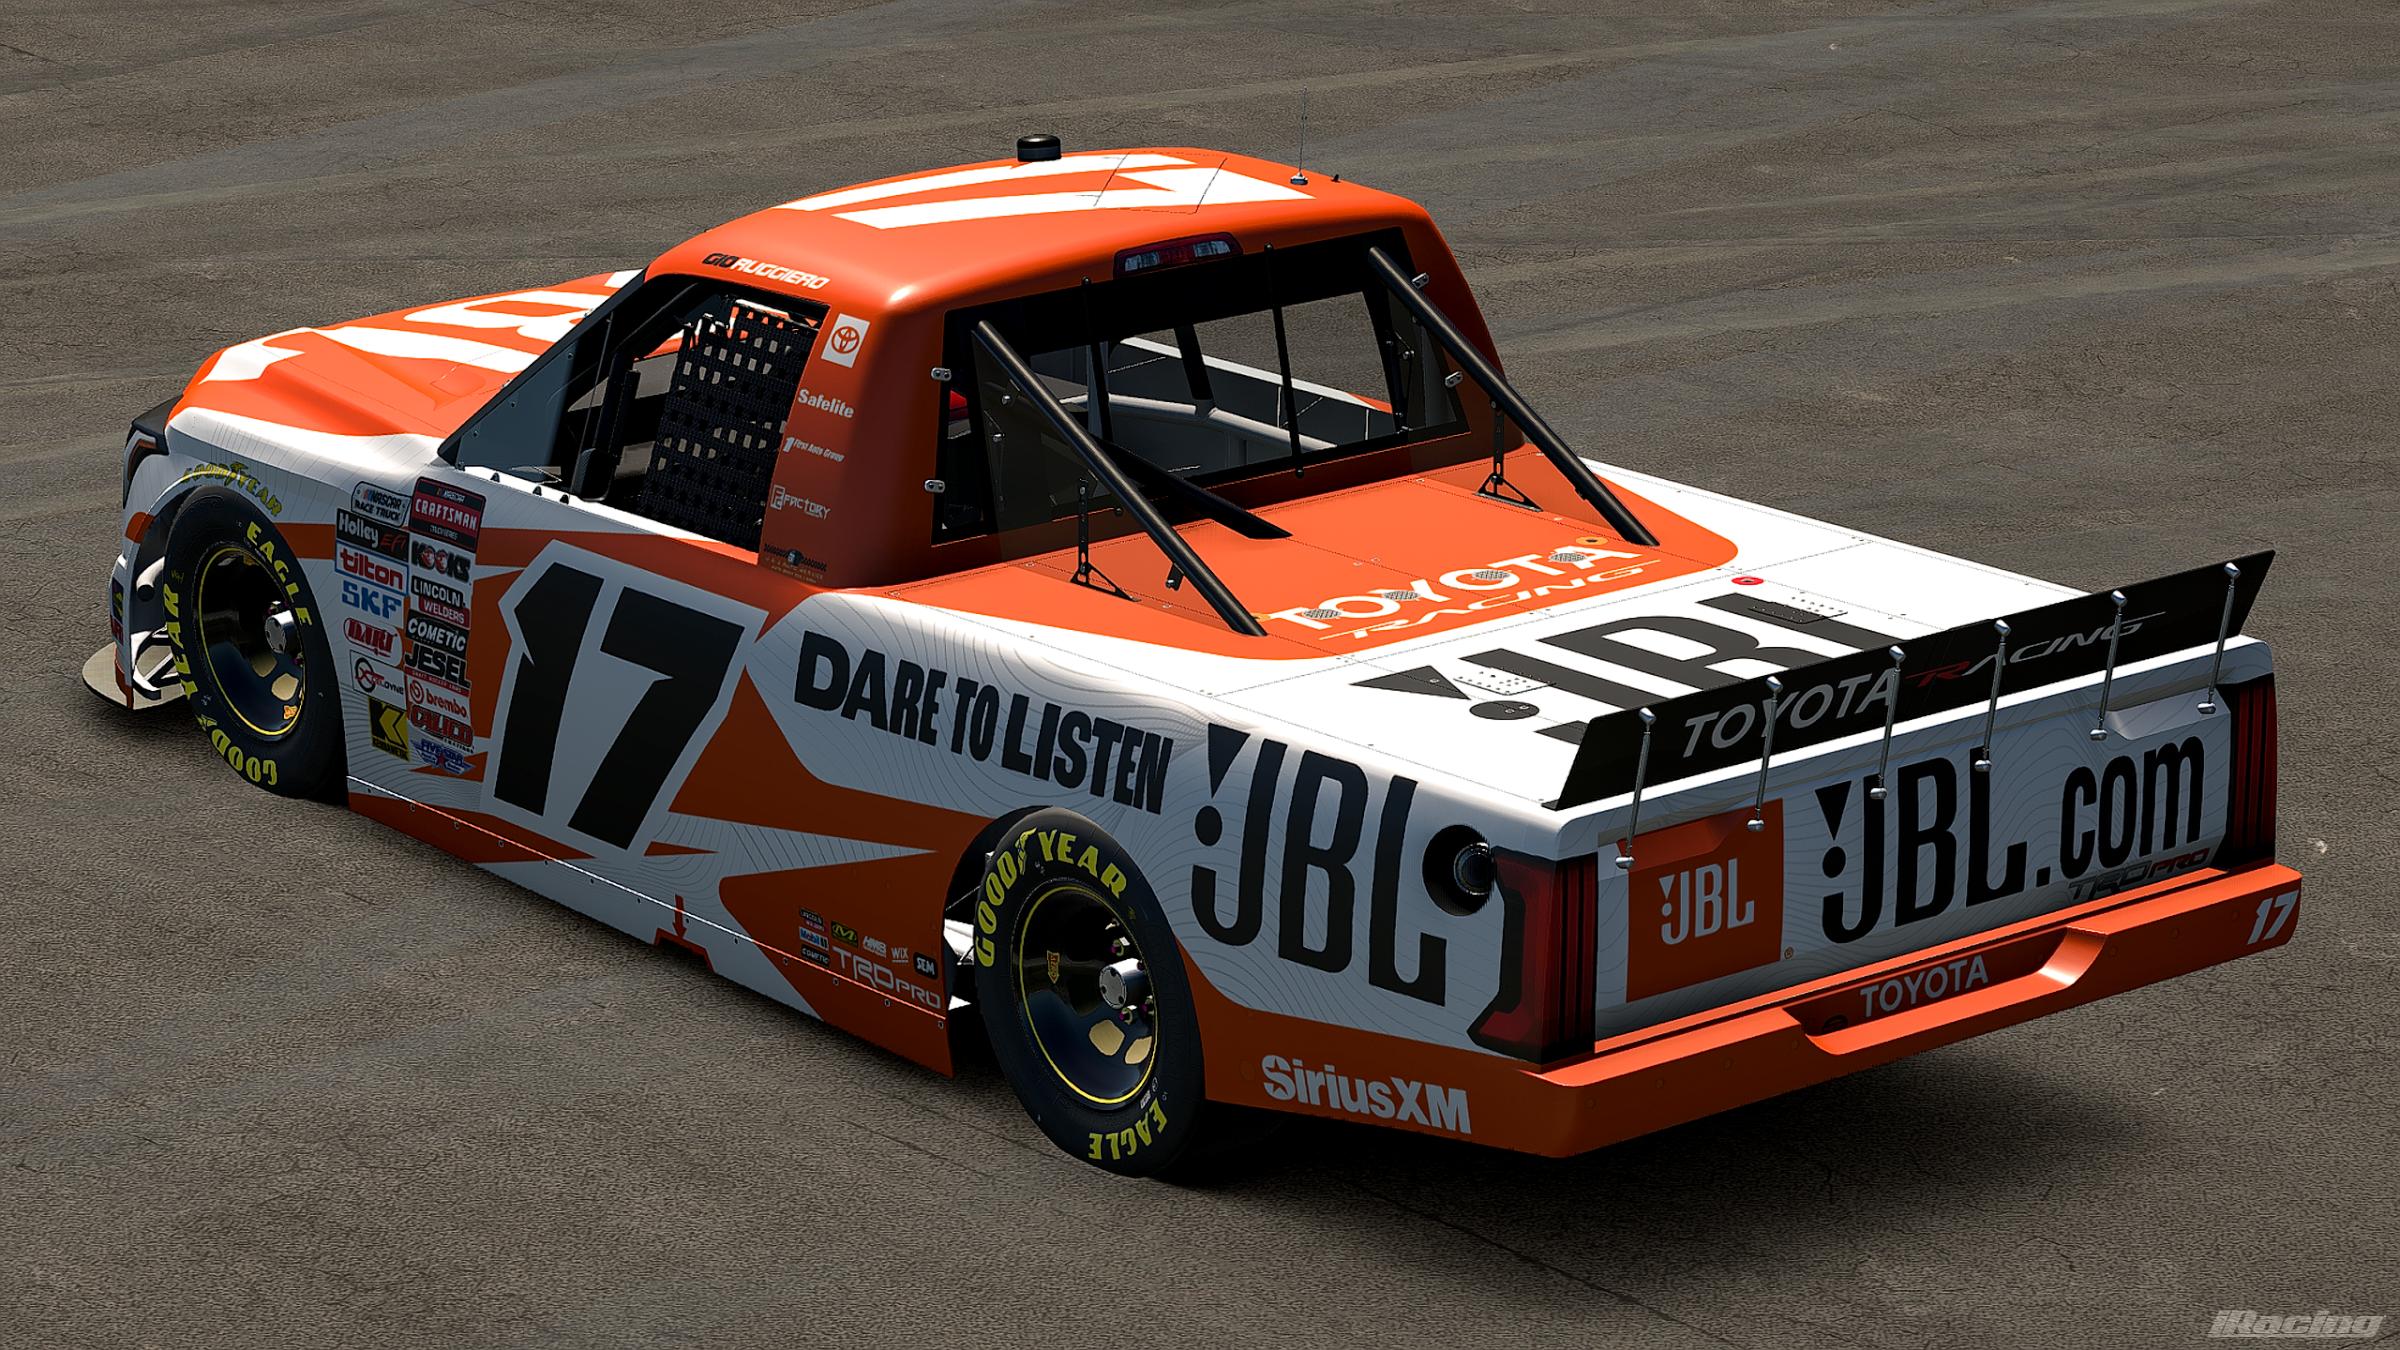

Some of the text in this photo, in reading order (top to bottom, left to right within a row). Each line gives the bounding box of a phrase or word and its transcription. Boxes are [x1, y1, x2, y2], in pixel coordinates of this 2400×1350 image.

[798, 388, 855, 418] Safelite
[354, 500, 401, 521] RACE TRUCK
[362, 487, 402, 509] NASCAR
[415, 498, 478, 531] CRAFTSMAN
[338, 512, 379, 548] Holley
[246, 521, 312, 627] EAGLE
[340, 548, 403, 590] tilton
[412, 540, 471, 583] KOOKS
[342, 580, 402, 619] SKF
[413, 579, 462, 606] LINCOLN
[1269, 545, 1645, 631] TOYOTA
[1319, 559, 1661, 640] RACING
[423, 599, 465, 624] WELDERS
[408, 617, 467, 652] COMETIC
[405, 643, 471, 688] JESEL
[1683, 611, 2166, 757] TOYOTA RACING
[425, 688, 467, 717] brembo
[494, 561, 746, 850] 17
[794, 630, 1173, 815] DARE TO LISTEN
[410, 704, 474, 746] CALICO
[1191, 738, 1448, 1007] JBL
[974, 826, 1128, 968] GOODYEAR
[1661, 857, 1755, 945] JBL
[2247, 890, 2300, 945] 17
[891, 947, 909, 960] WIX
[915, 956, 936, 976] SEM
[832, 945, 942, 1009] TRD PRO
[1860, 955, 1989, 1018] TOYOTA
[1261, 1055, 1472, 1135] SiriusXM
[1088, 1099, 1168, 1160] EAGLE
